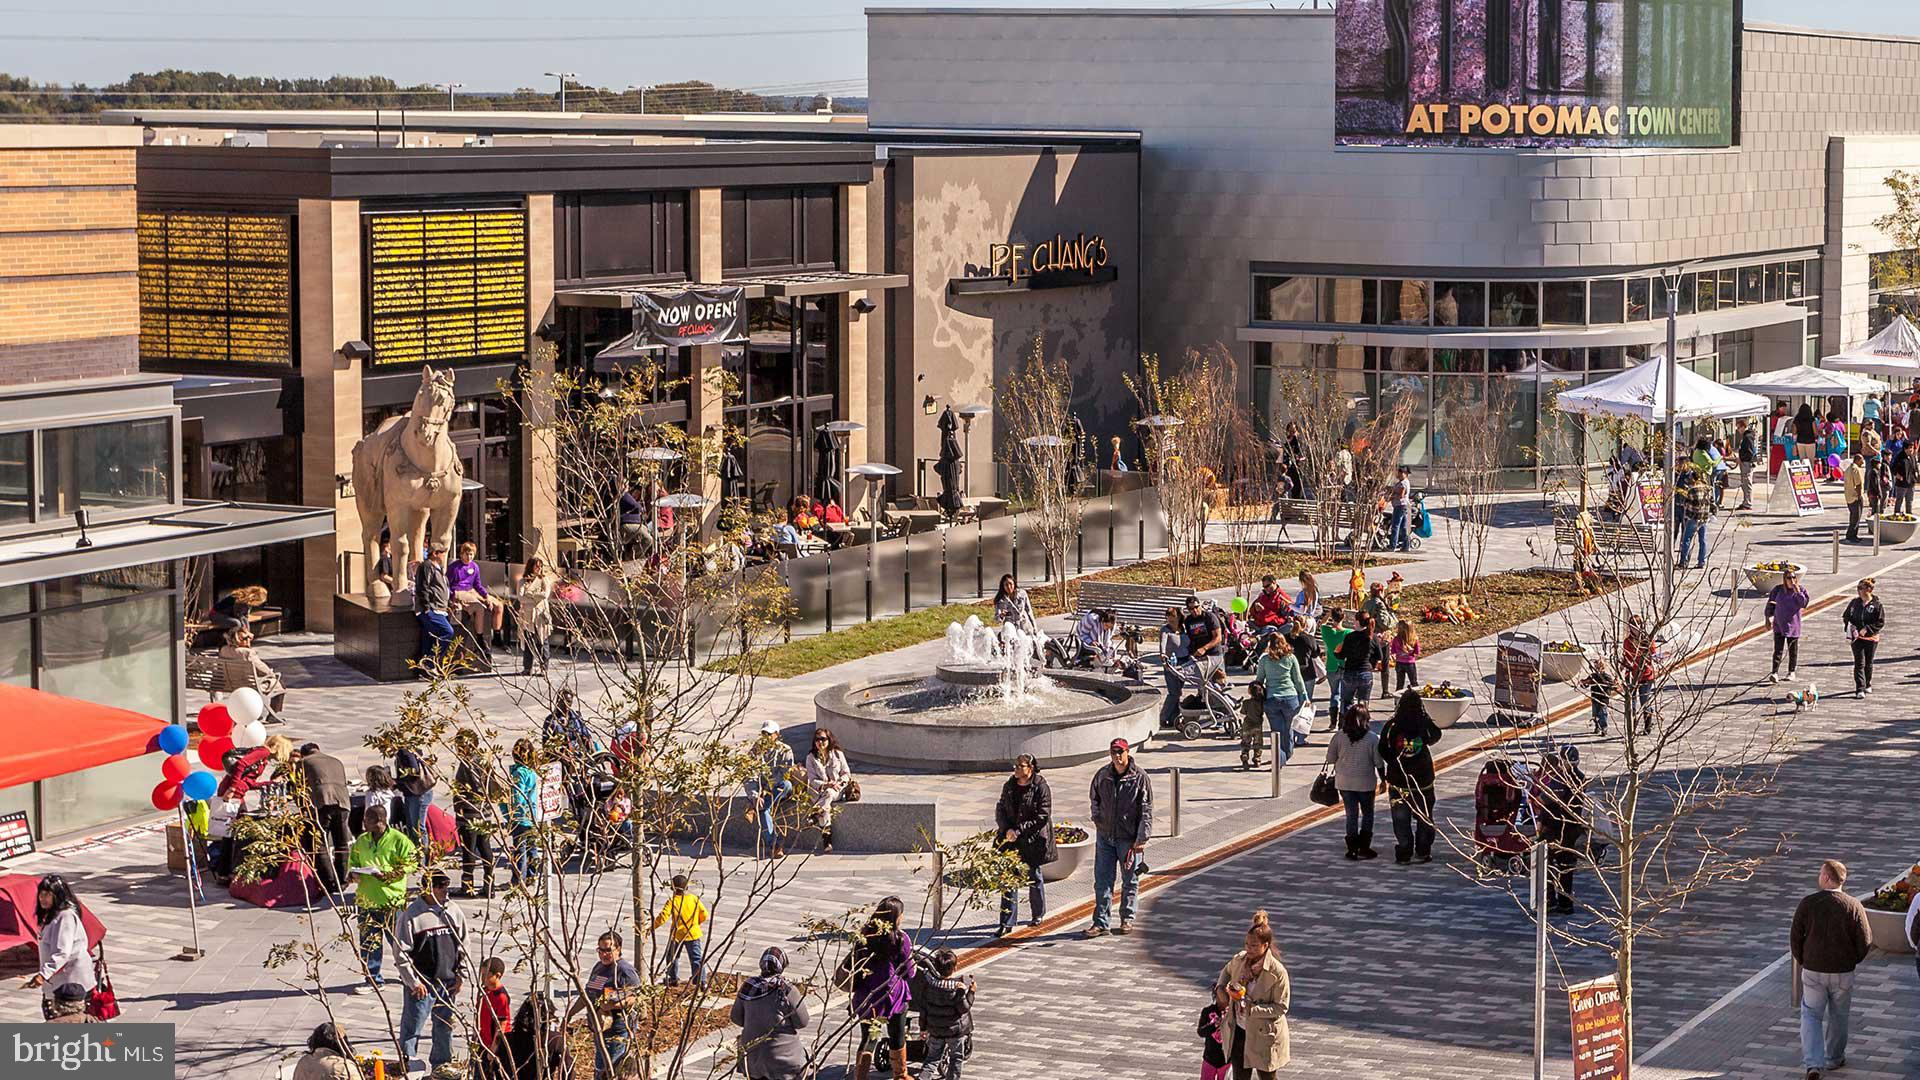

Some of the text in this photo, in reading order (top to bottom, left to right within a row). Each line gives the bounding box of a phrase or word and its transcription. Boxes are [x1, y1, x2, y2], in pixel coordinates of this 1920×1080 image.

[1405, 104, 1721, 135] AT POTOMAC TOWN CENTER
[657, 301, 737, 325] NOW OPEN!
[1873, 348, 1914, 358] unleashed
[1573, 996, 1594, 1013] GRAND
[1576, 1023, 1585, 1033] On
